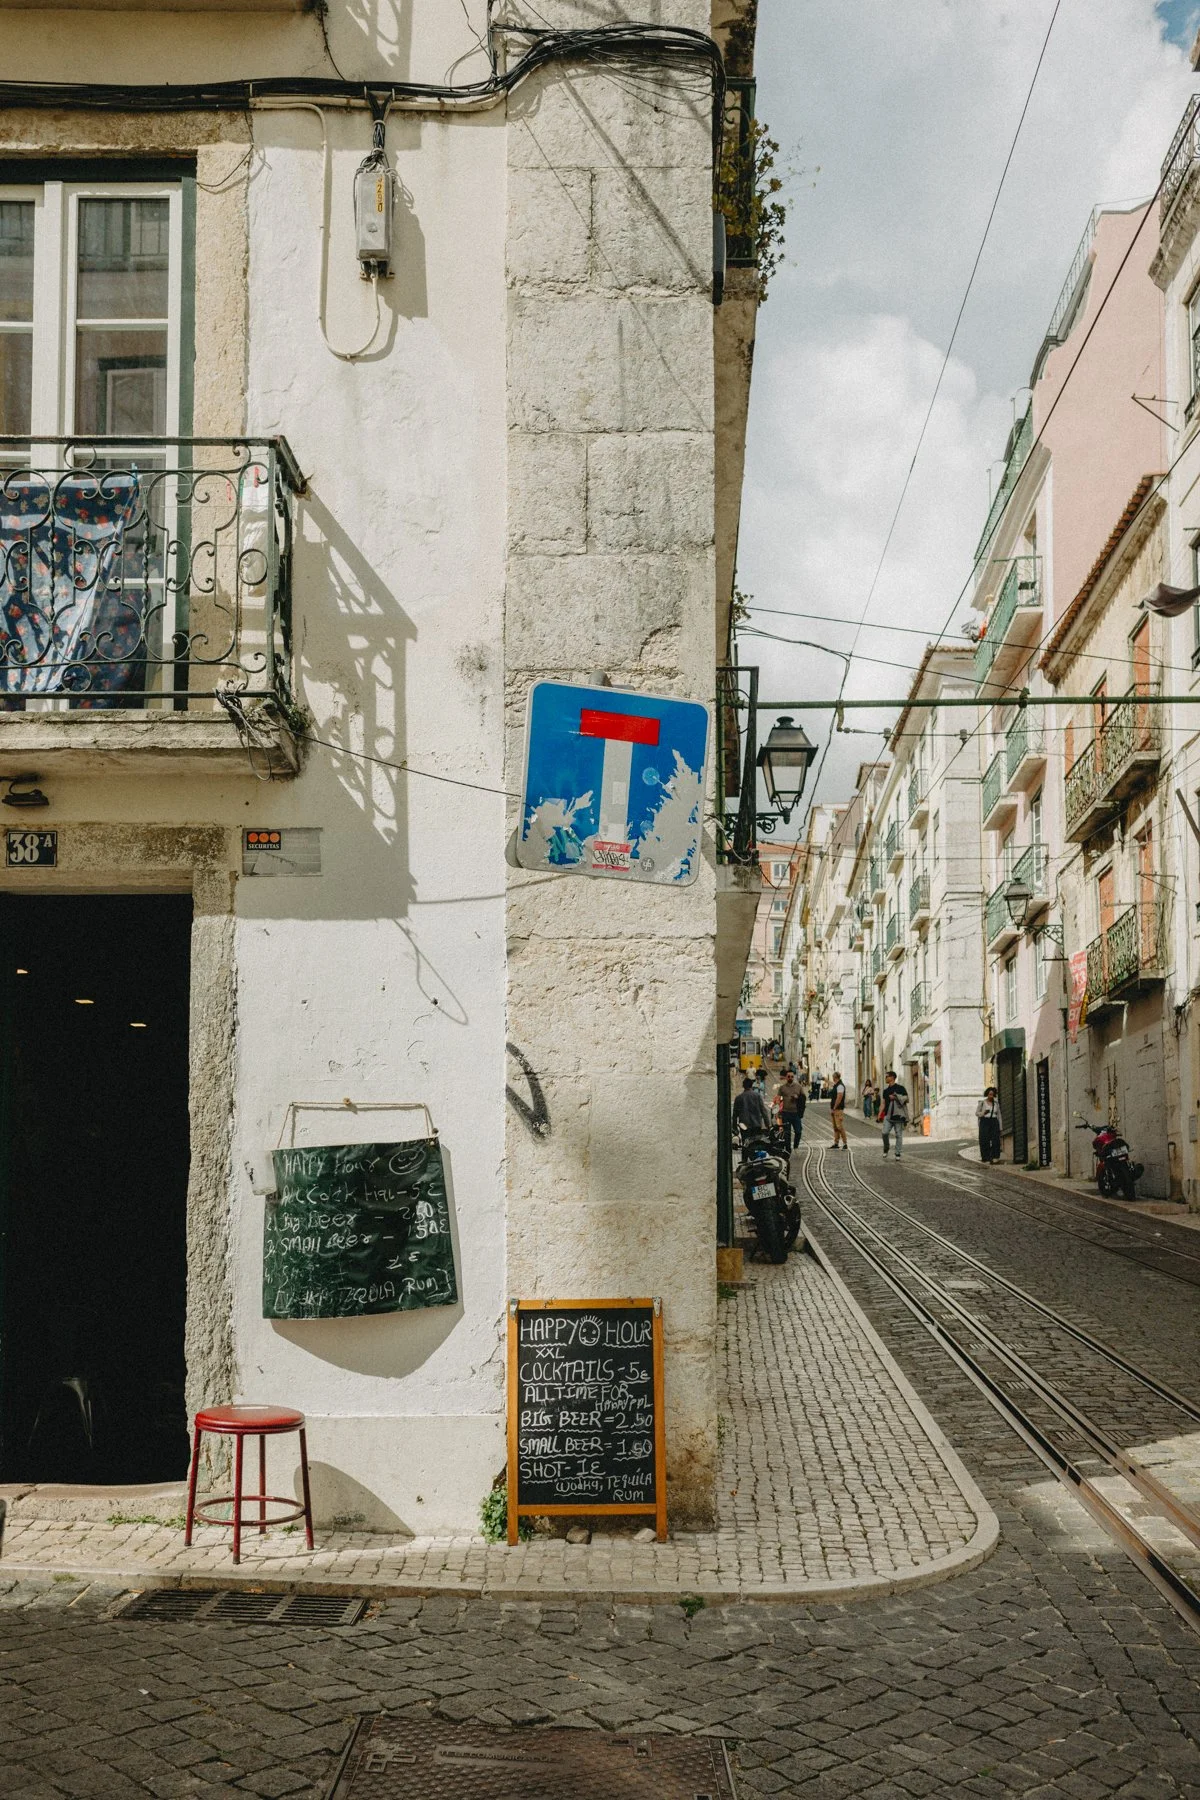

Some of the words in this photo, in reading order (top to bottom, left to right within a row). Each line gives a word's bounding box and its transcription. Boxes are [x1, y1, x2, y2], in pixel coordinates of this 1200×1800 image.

[282, 1152, 325, 1178] HAPPY
[520, 1317, 579, 1344] HAPPY
[606, 1320, 653, 1344] HOUR
[535, 1347, 565, 1359] XXL
[519, 1359, 614, 1382] COCKTAILS
[525, 1385, 555, 1403] ALL
[553, 1386, 598, 1399] TIME
[601, 1383, 630, 1402] FOR
[521, 1409, 553, 1427] BIG
[559, 1410, 601, 1428] BEER
[519, 1435, 561, 1456] SMALL
[565, 1436, 603, 1454] BEER
[520, 1461, 566, 1479] SHOT
[613, 1489, 644, 1502] RUM
